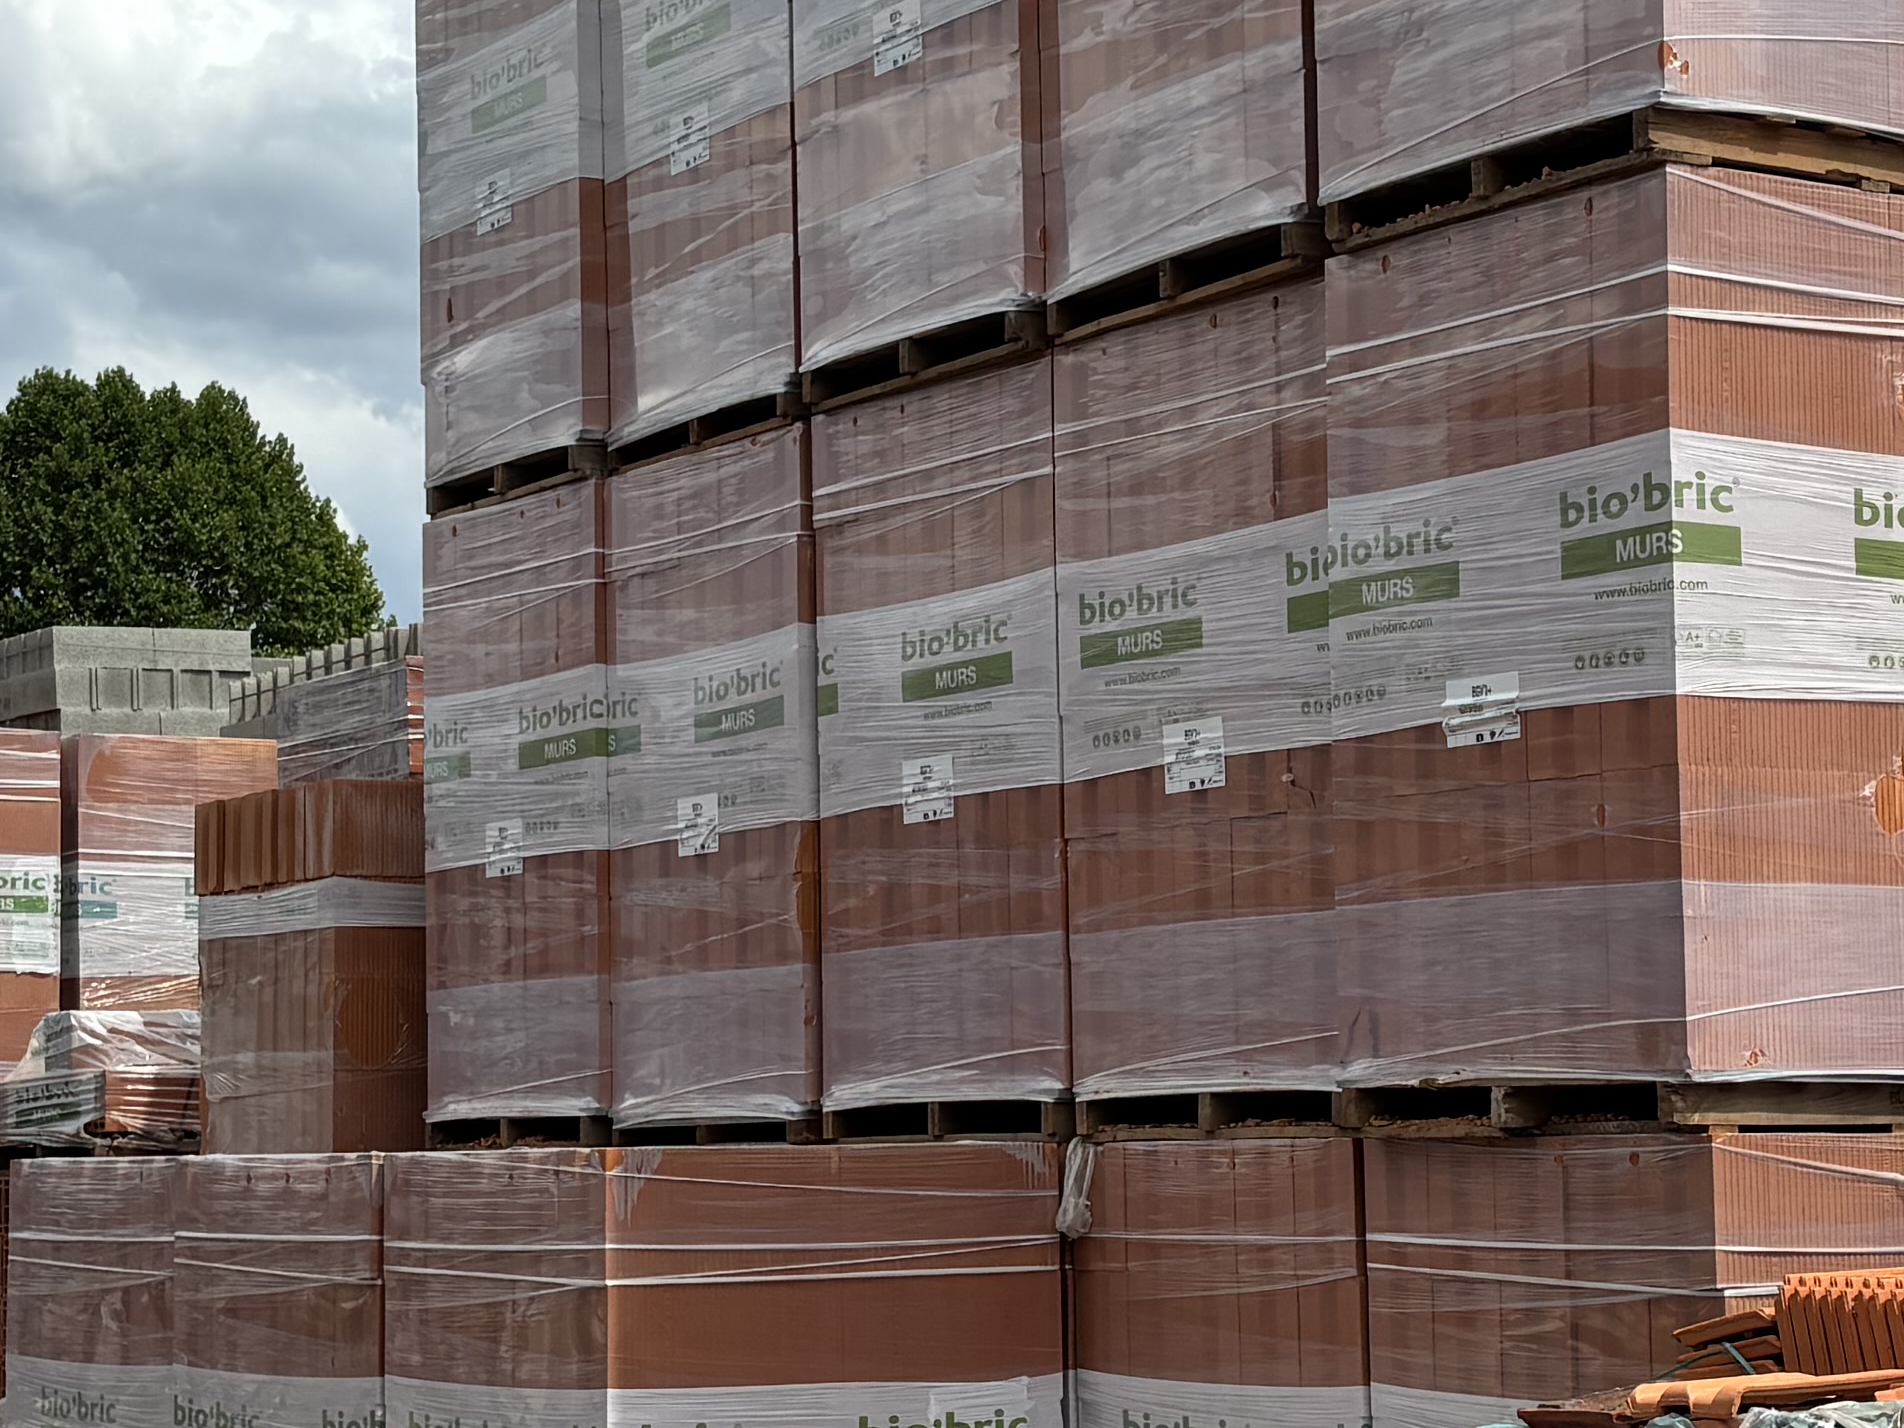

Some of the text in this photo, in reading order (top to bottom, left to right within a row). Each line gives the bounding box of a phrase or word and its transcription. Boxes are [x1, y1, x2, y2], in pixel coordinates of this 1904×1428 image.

[1559, 470, 1734, 529] bio'bric
[1614, 528, 1684, 564] MURS
[1078, 576, 1198, 627] bio'bric
[1361, 576, 1415, 606] MURS
[1594, 577, 1709, 601] www.biobric.com
[1345, 615, 1433, 642] www.biobric.com
[1116, 629, 1163, 657] MURS
[935, 666, 977, 690] MURS
[720, 710, 756, 732] MURS
[544, 738, 577, 760] MURS
